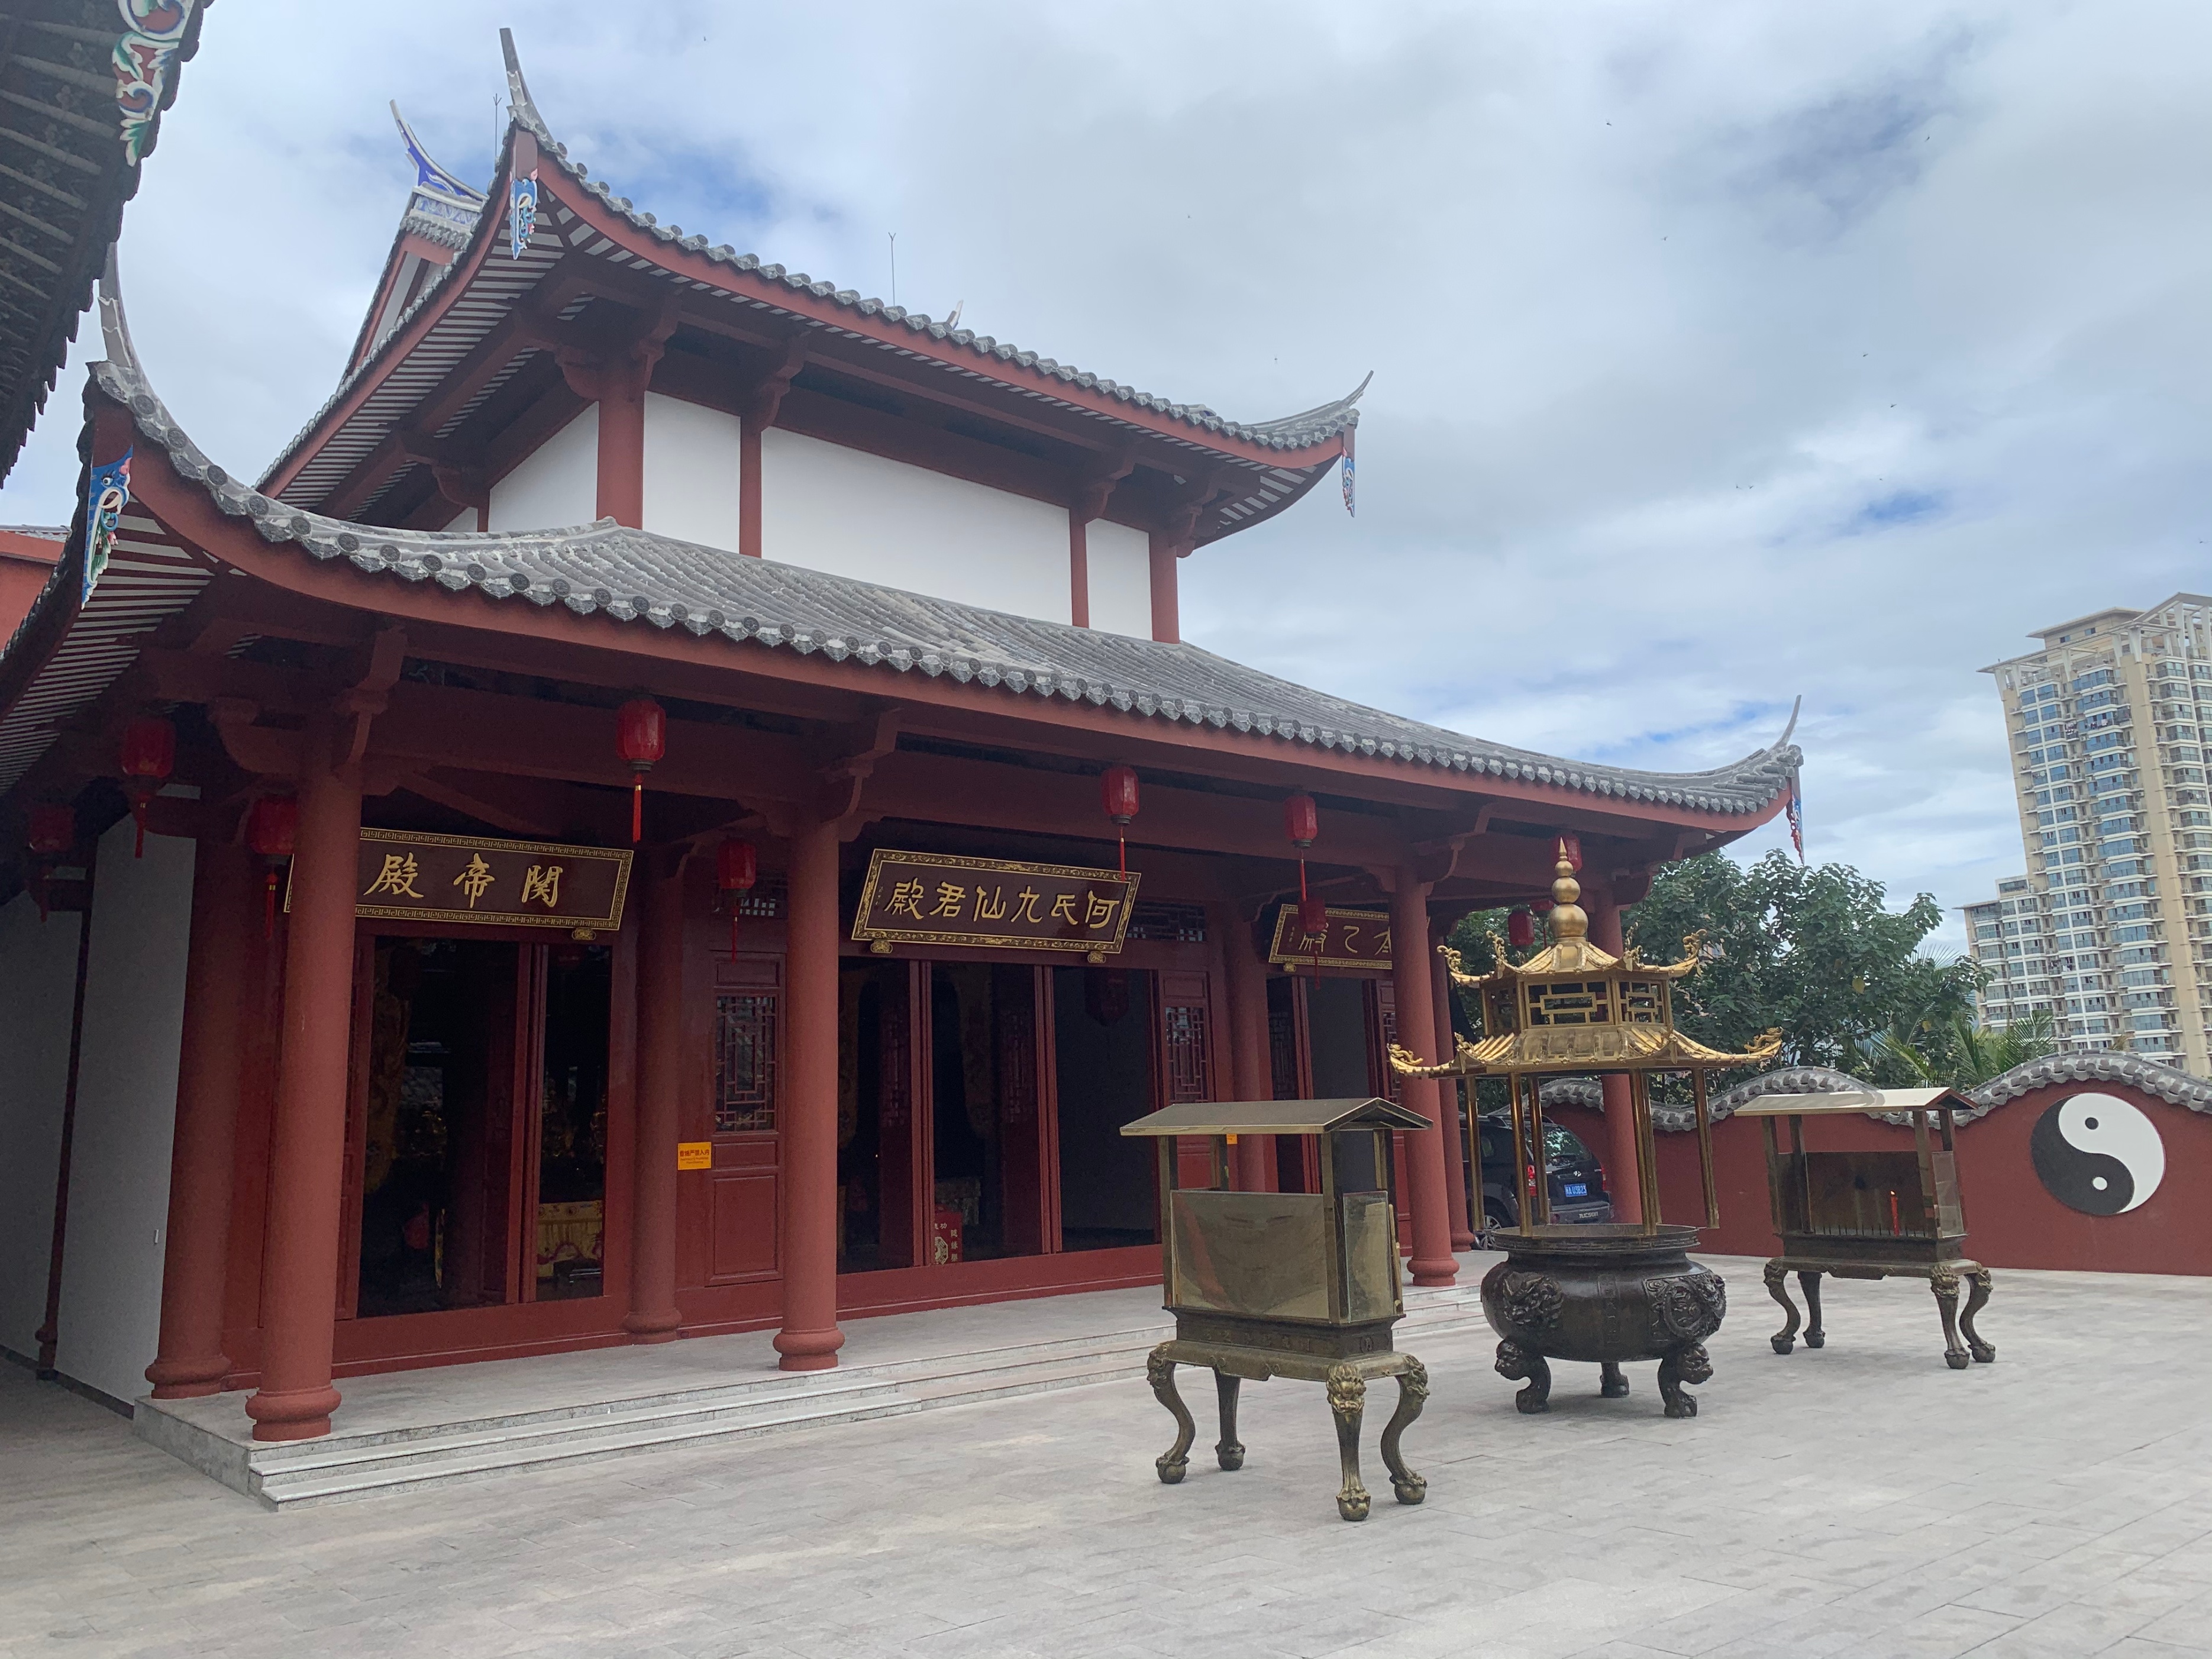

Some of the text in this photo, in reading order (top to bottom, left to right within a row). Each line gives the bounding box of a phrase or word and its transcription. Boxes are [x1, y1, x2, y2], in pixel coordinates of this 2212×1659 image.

[884, 877, 1119, 928] 何氏九仙君殿
